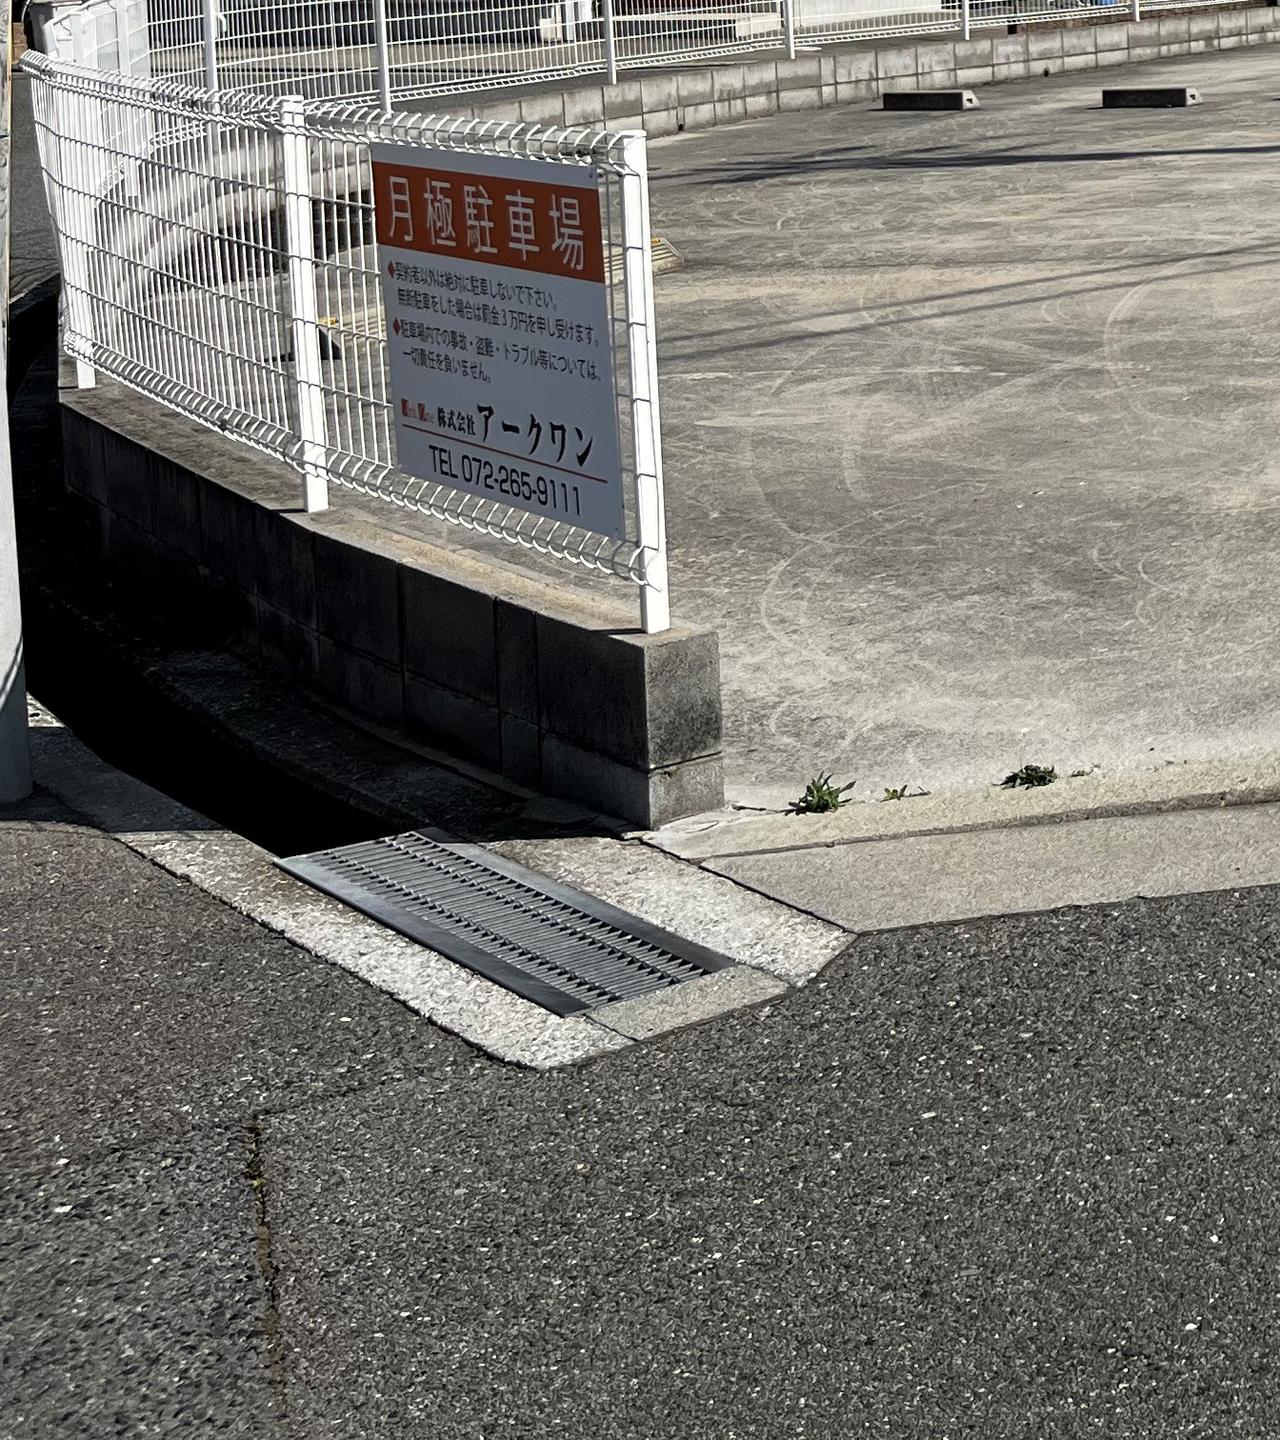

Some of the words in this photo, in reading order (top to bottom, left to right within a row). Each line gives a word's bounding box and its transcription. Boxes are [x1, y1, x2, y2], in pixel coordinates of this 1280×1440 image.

[388, 175, 585, 271] 月極駐車場
[395, 262, 558, 311] 契約者以外は絶対に駐車しないで下さい。
[403, 346, 492, 384] 一切責任を負いません。
[429, 445, 458, 479] TEL
[461, 455, 581, 517] 072-265-9111
